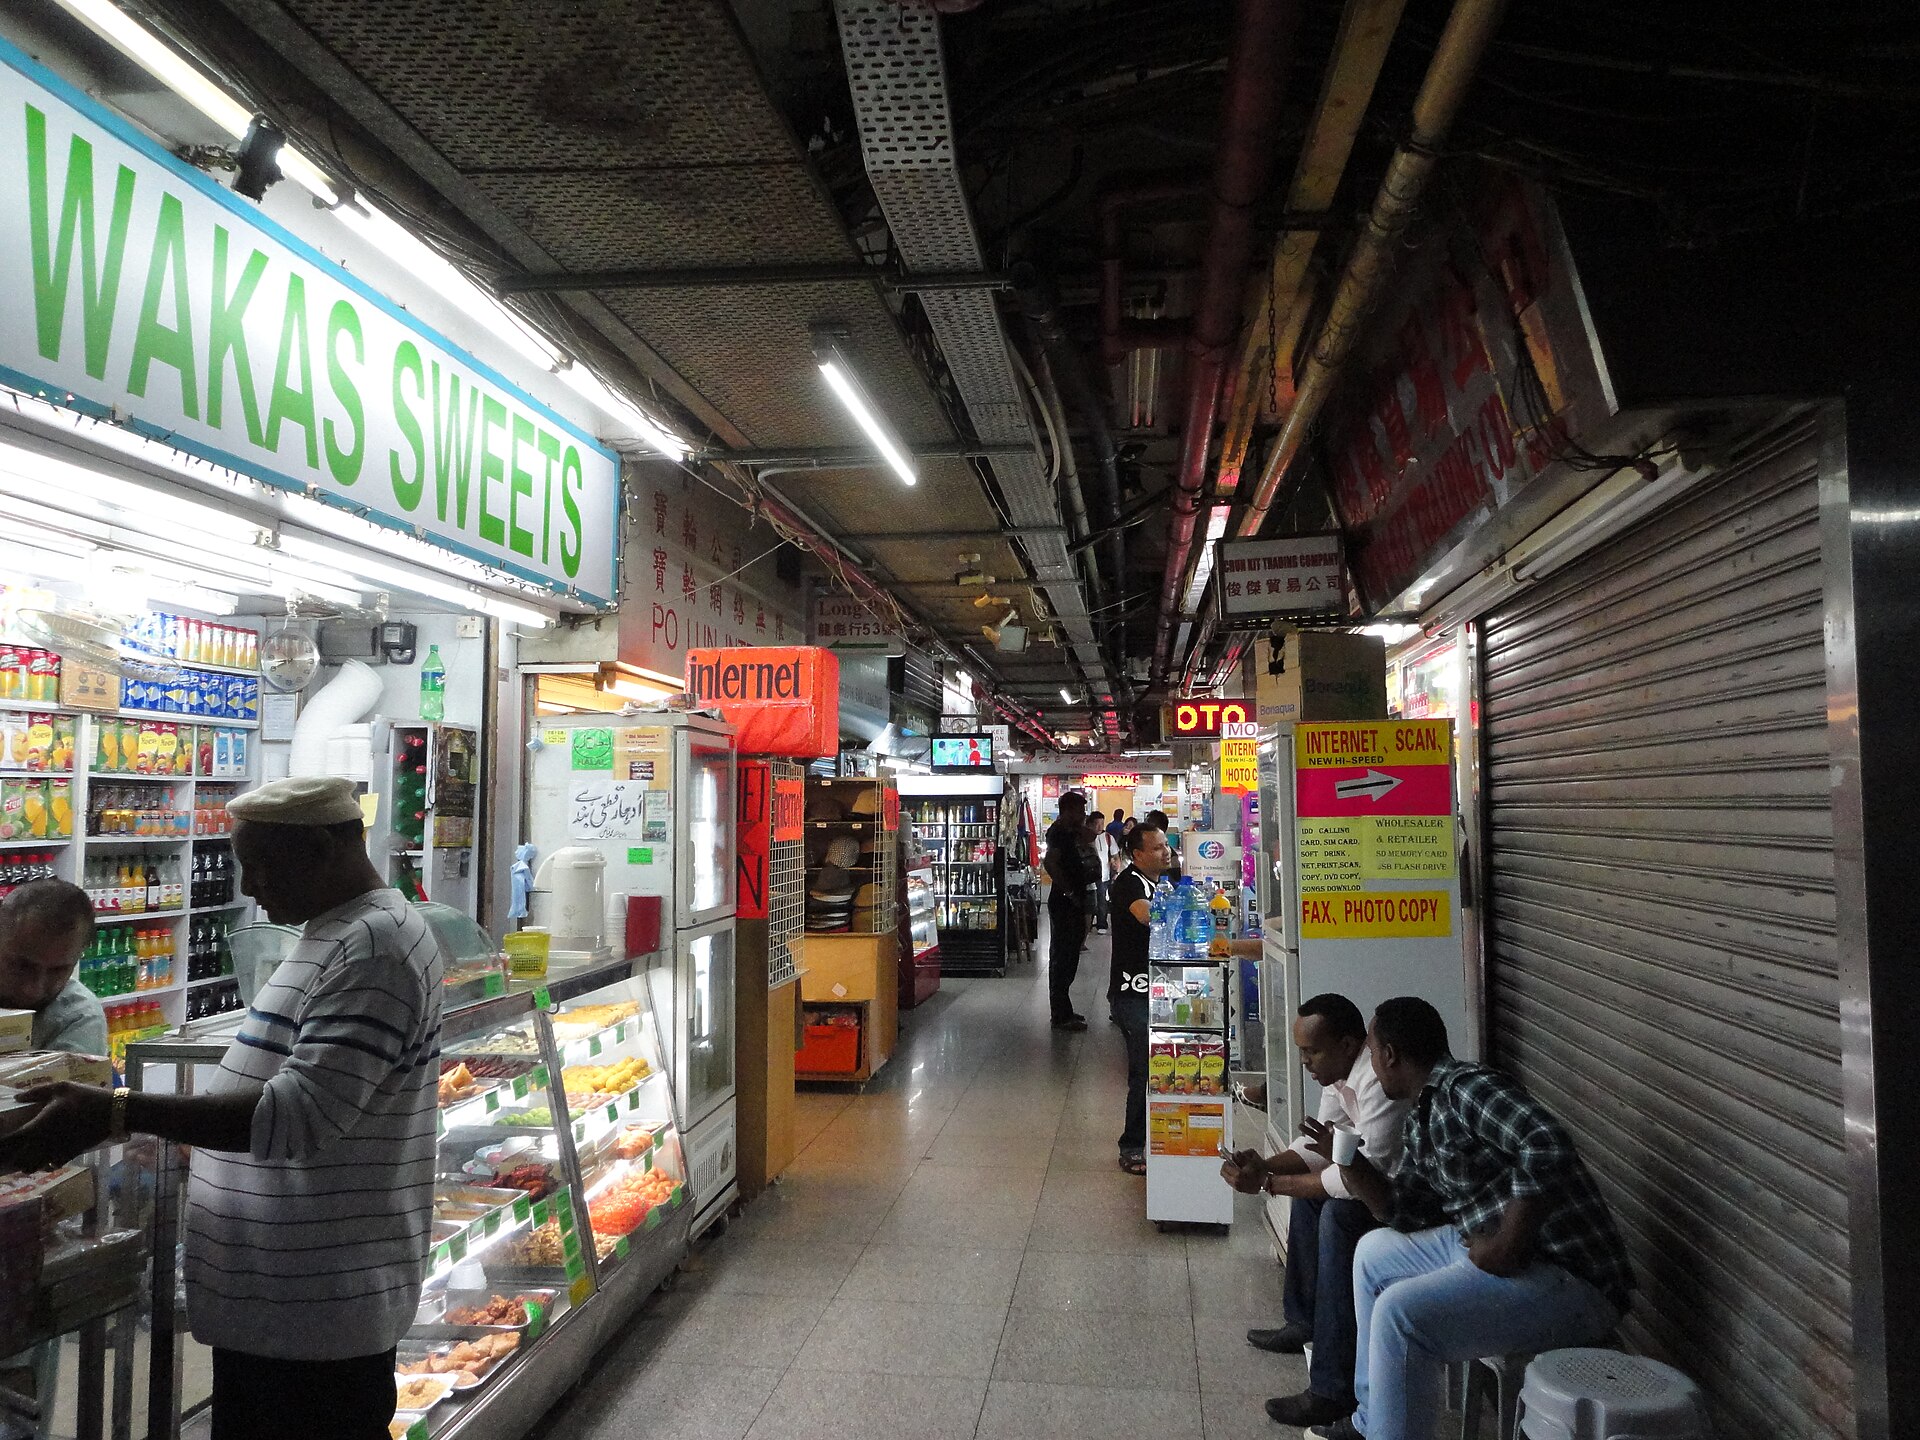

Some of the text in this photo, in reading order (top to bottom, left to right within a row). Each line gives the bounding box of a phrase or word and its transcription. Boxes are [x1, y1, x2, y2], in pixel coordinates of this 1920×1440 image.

[26, 103, 584, 579] WAKAS SWEETS
[819, 601, 863, 619] Long
[652, 602, 678, 650] PO
[690, 652, 804, 700] internet
[1260, 704, 1295, 716] Bonaqua
[1306, 729, 1378, 754] INTERNET
[1309, 755, 1384, 765] NEW HI-SPEED
[1376, 819, 1444, 828] WHOLESALER
[1388, 835, 1438, 844] RETAILER
[1388, 850, 1423, 858] MEMORY
[1344, 899, 1395, 923] PHOTO
[1399, 898, 1438, 922] COPY
